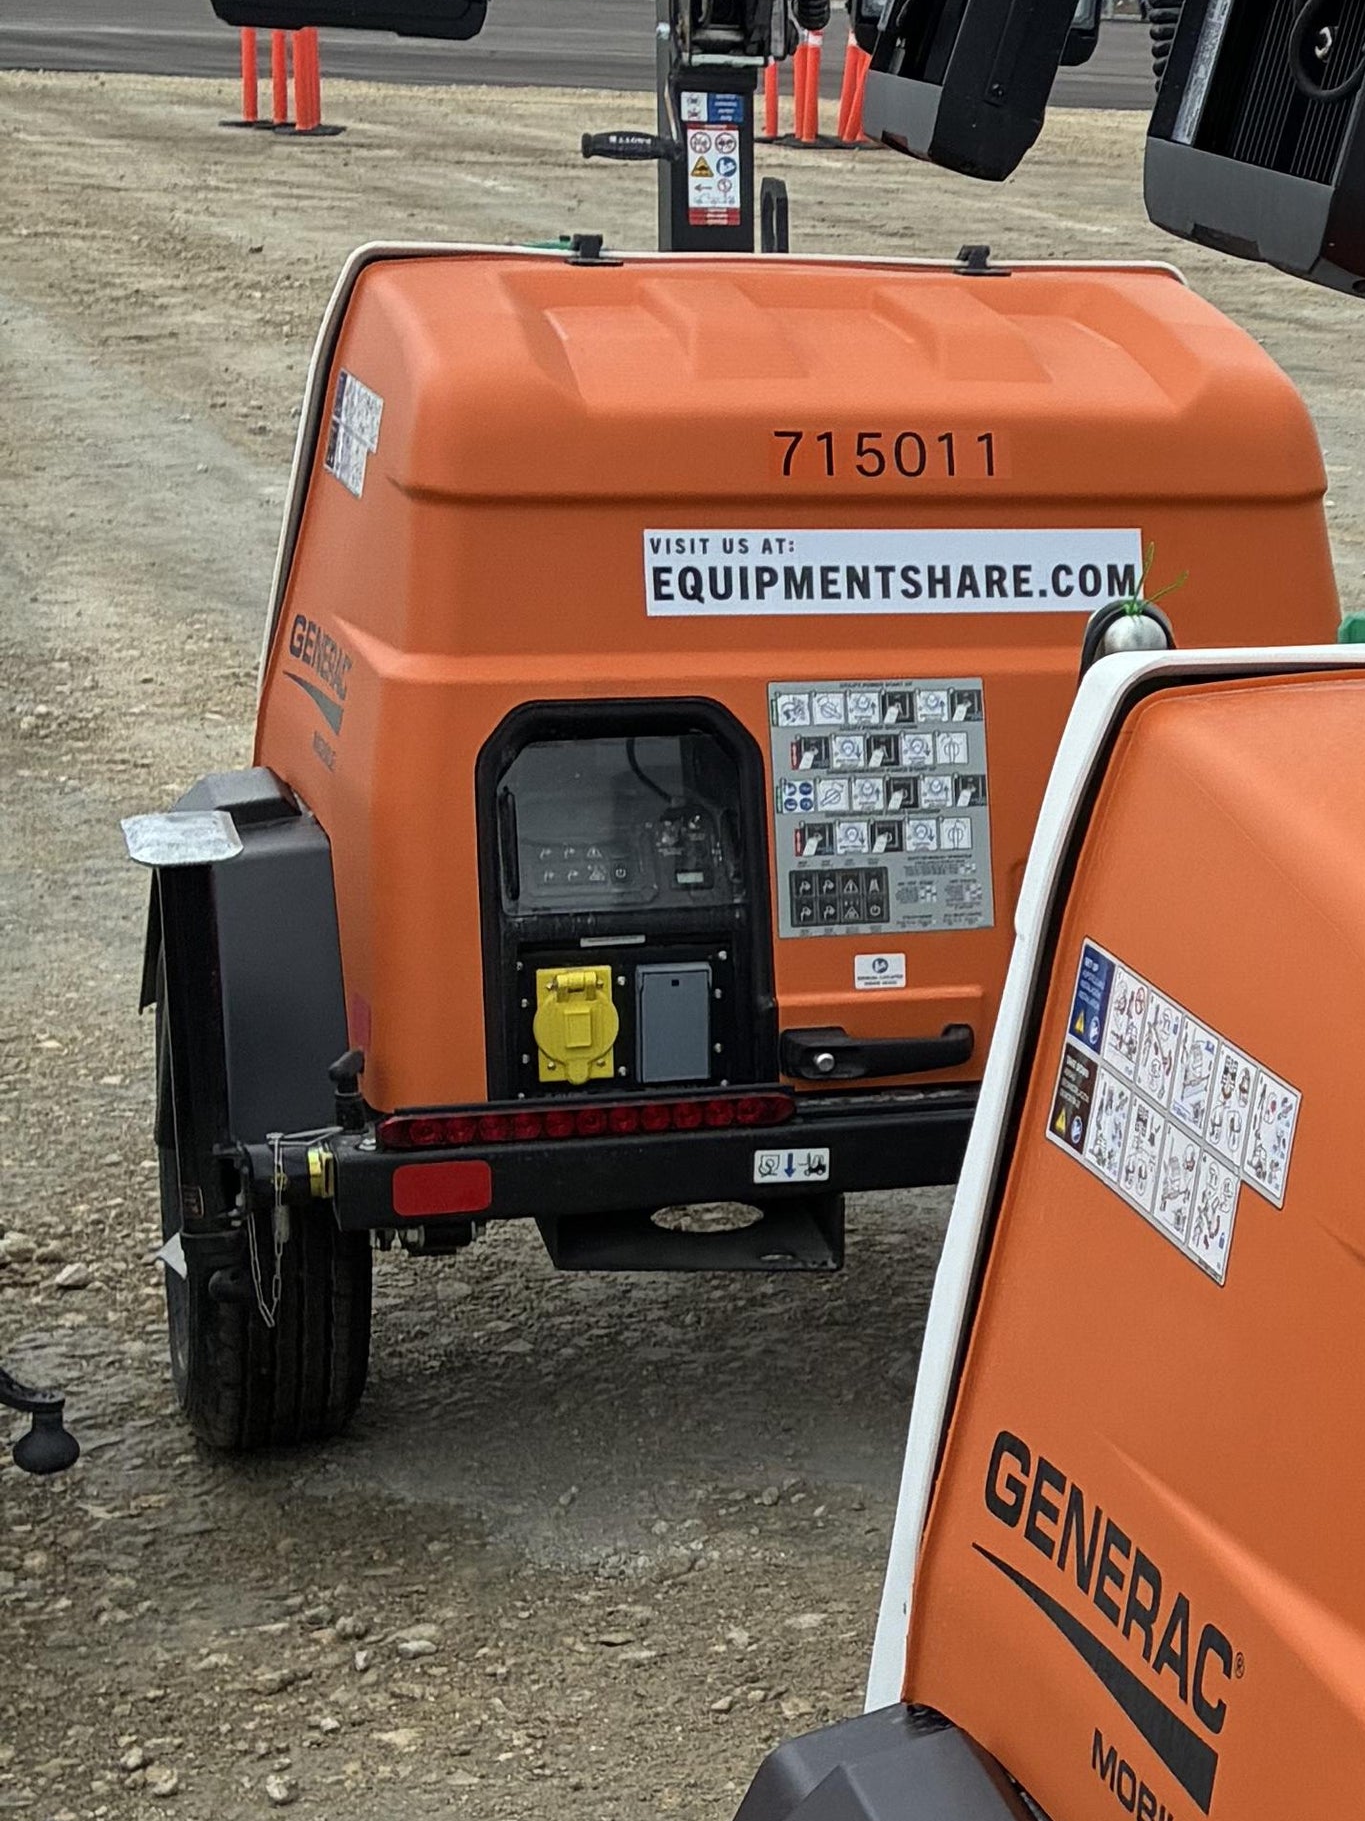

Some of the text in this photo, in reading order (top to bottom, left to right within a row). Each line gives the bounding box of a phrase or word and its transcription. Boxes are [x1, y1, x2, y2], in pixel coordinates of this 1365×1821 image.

[774, 431, 994, 477] 715011
[650, 537, 797, 556] VISIT US AT:
[652, 564, 1137, 605] EQUIPMENTSHARE.COM
[984, 1430, 1233, 1736] GENERAC
